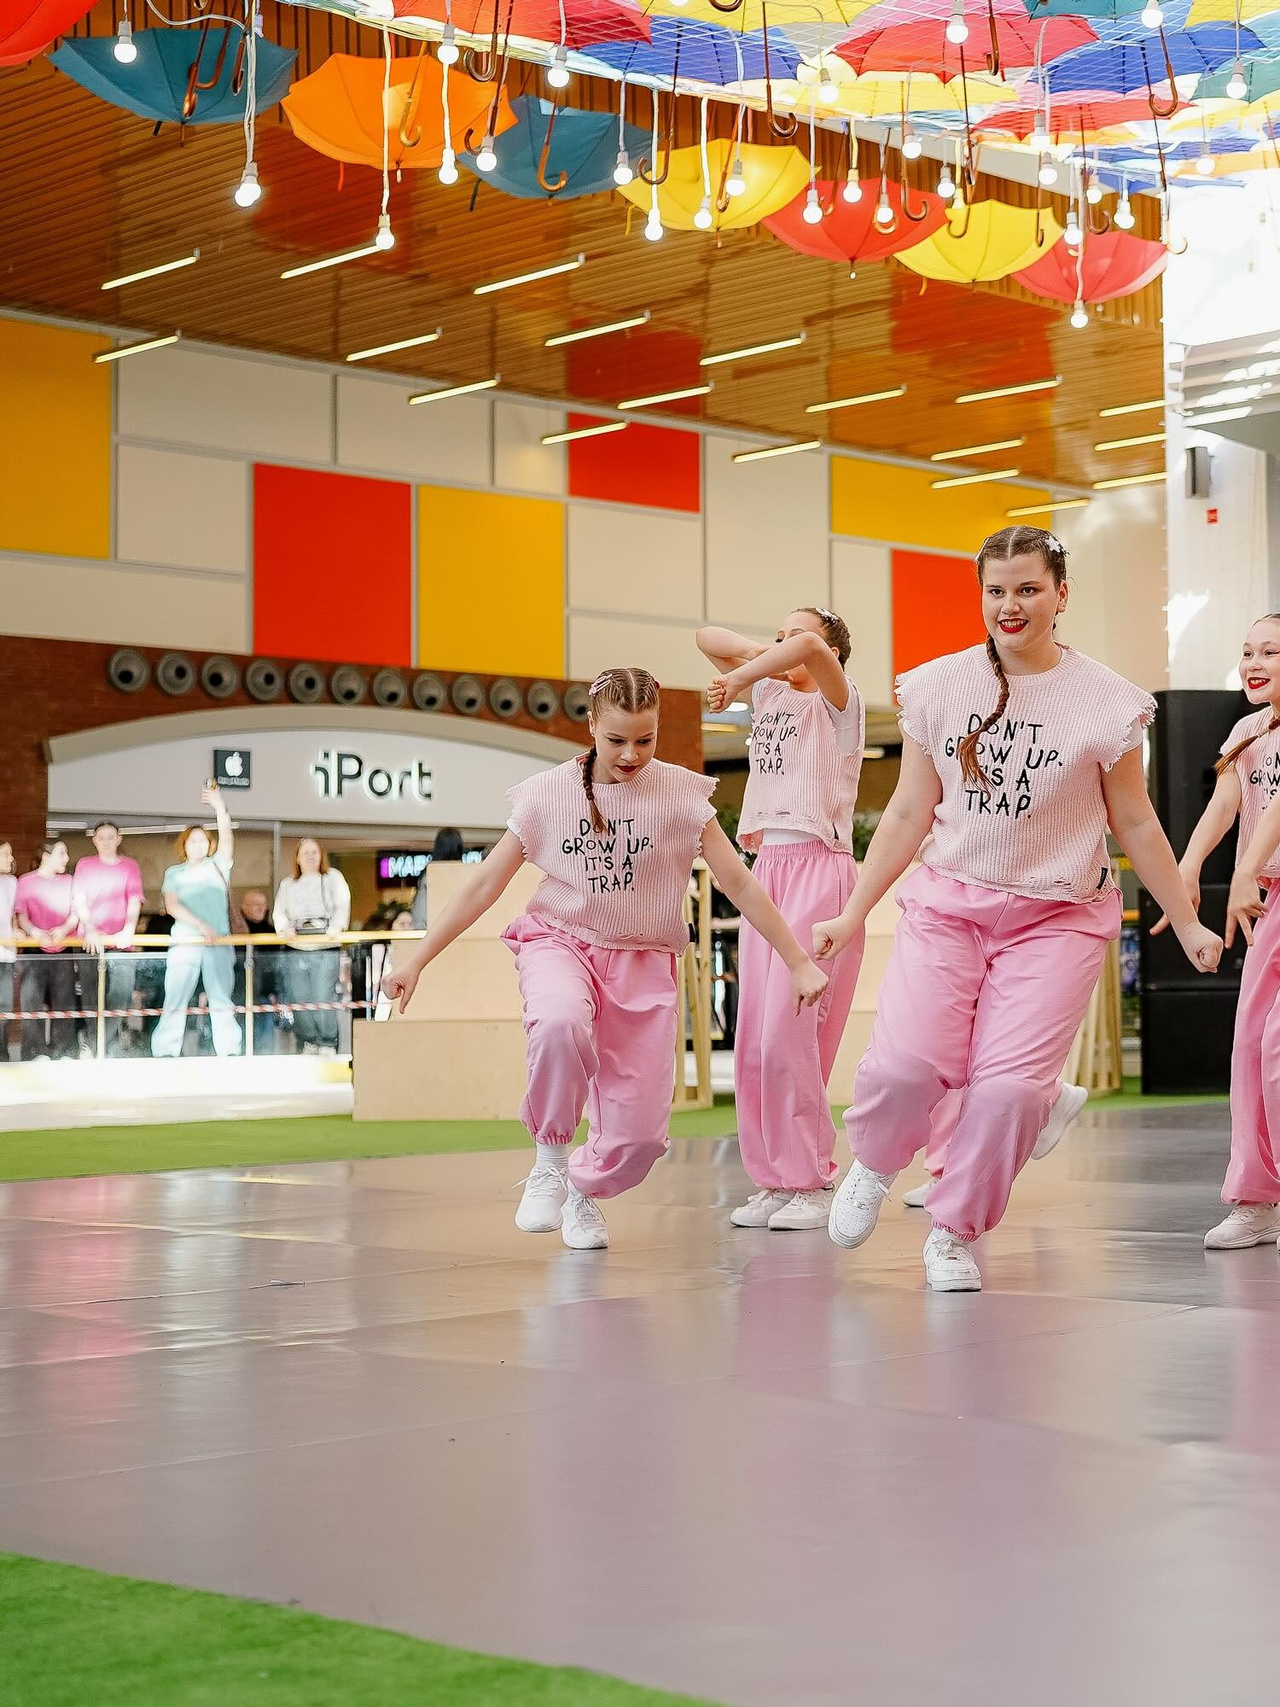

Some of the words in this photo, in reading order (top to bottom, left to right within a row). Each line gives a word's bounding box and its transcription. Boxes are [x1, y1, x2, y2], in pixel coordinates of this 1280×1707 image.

[760, 711, 794, 725] DON'T
[774, 742, 782, 757] A
[1026, 747, 1063, 769] UP.
[310, 750, 432, 801] iPort
[1016, 768, 1031, 792] A
[965, 789, 1032, 819] TRAP.
[562, 838, 616, 855] GROW
[627, 837, 653, 854] UP.
[585, 856, 614, 871] IT'S
[622, 855, 633, 869] A
[588, 872, 635, 894] TRAP.
